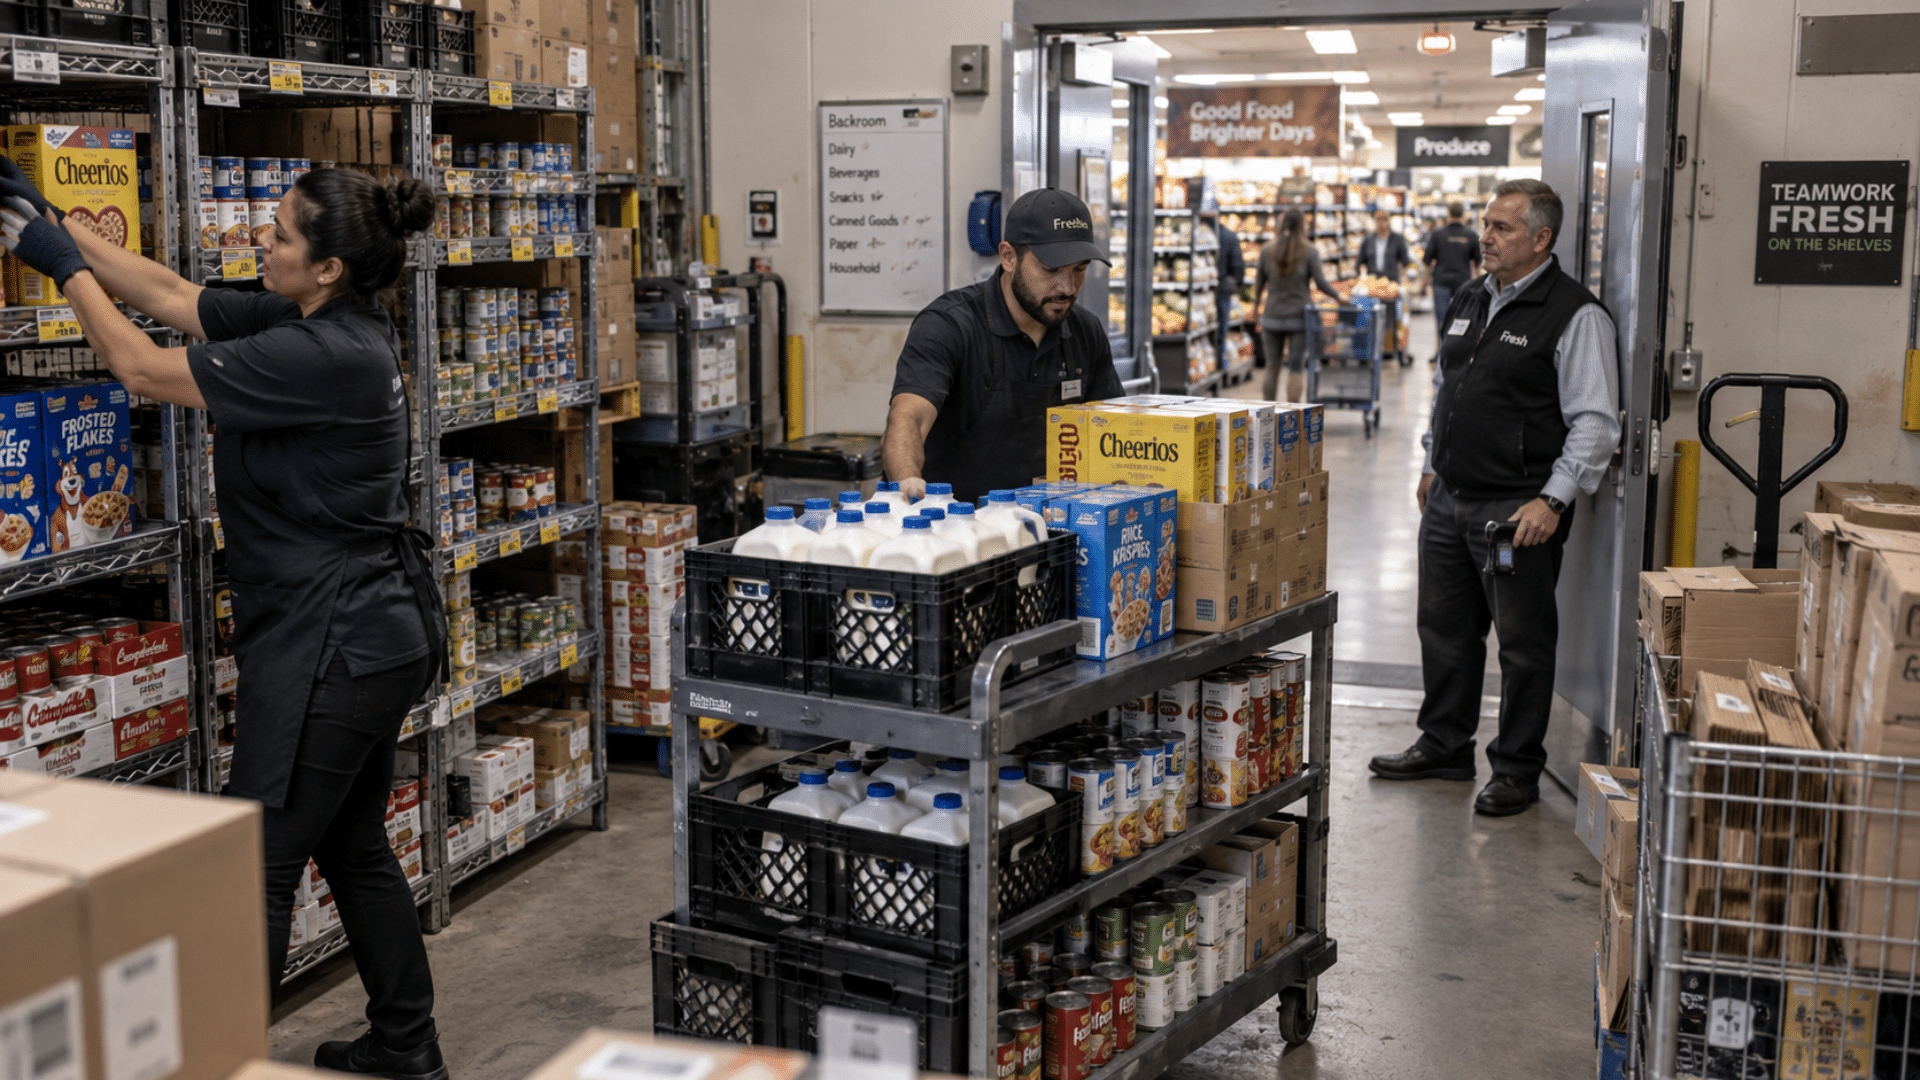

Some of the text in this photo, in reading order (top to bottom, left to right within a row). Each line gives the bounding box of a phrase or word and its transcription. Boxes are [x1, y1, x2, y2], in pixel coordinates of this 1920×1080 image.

[1190, 100, 1294, 121] Good Food
[829, 114, 886, 128] Backroom
[1190, 121, 1316, 146] Brighter Days
[829, 142, 855, 158] Dairy
[1414, 136, 1491, 156] Produce
[55, 156, 129, 186] Cheerios
[829, 165, 880, 181] Beverages
[829, 191, 865, 203] Snacks
[1771, 183, 1896, 201] TEAMWORK
[829, 214, 899, 226] Canned Goods
[1769, 205, 1894, 233] FRESH
[829, 237, 859, 252] Paper
[1768, 238, 1892, 252] ON THE SHELVES
[829, 261, 881, 274] Household
[1500, 330, 1528, 347] Fresh
[62, 411, 116, 439] FROSTED
[66, 429, 114, 454] FLAKES
[1100, 432, 1179, 463] Cheerios
